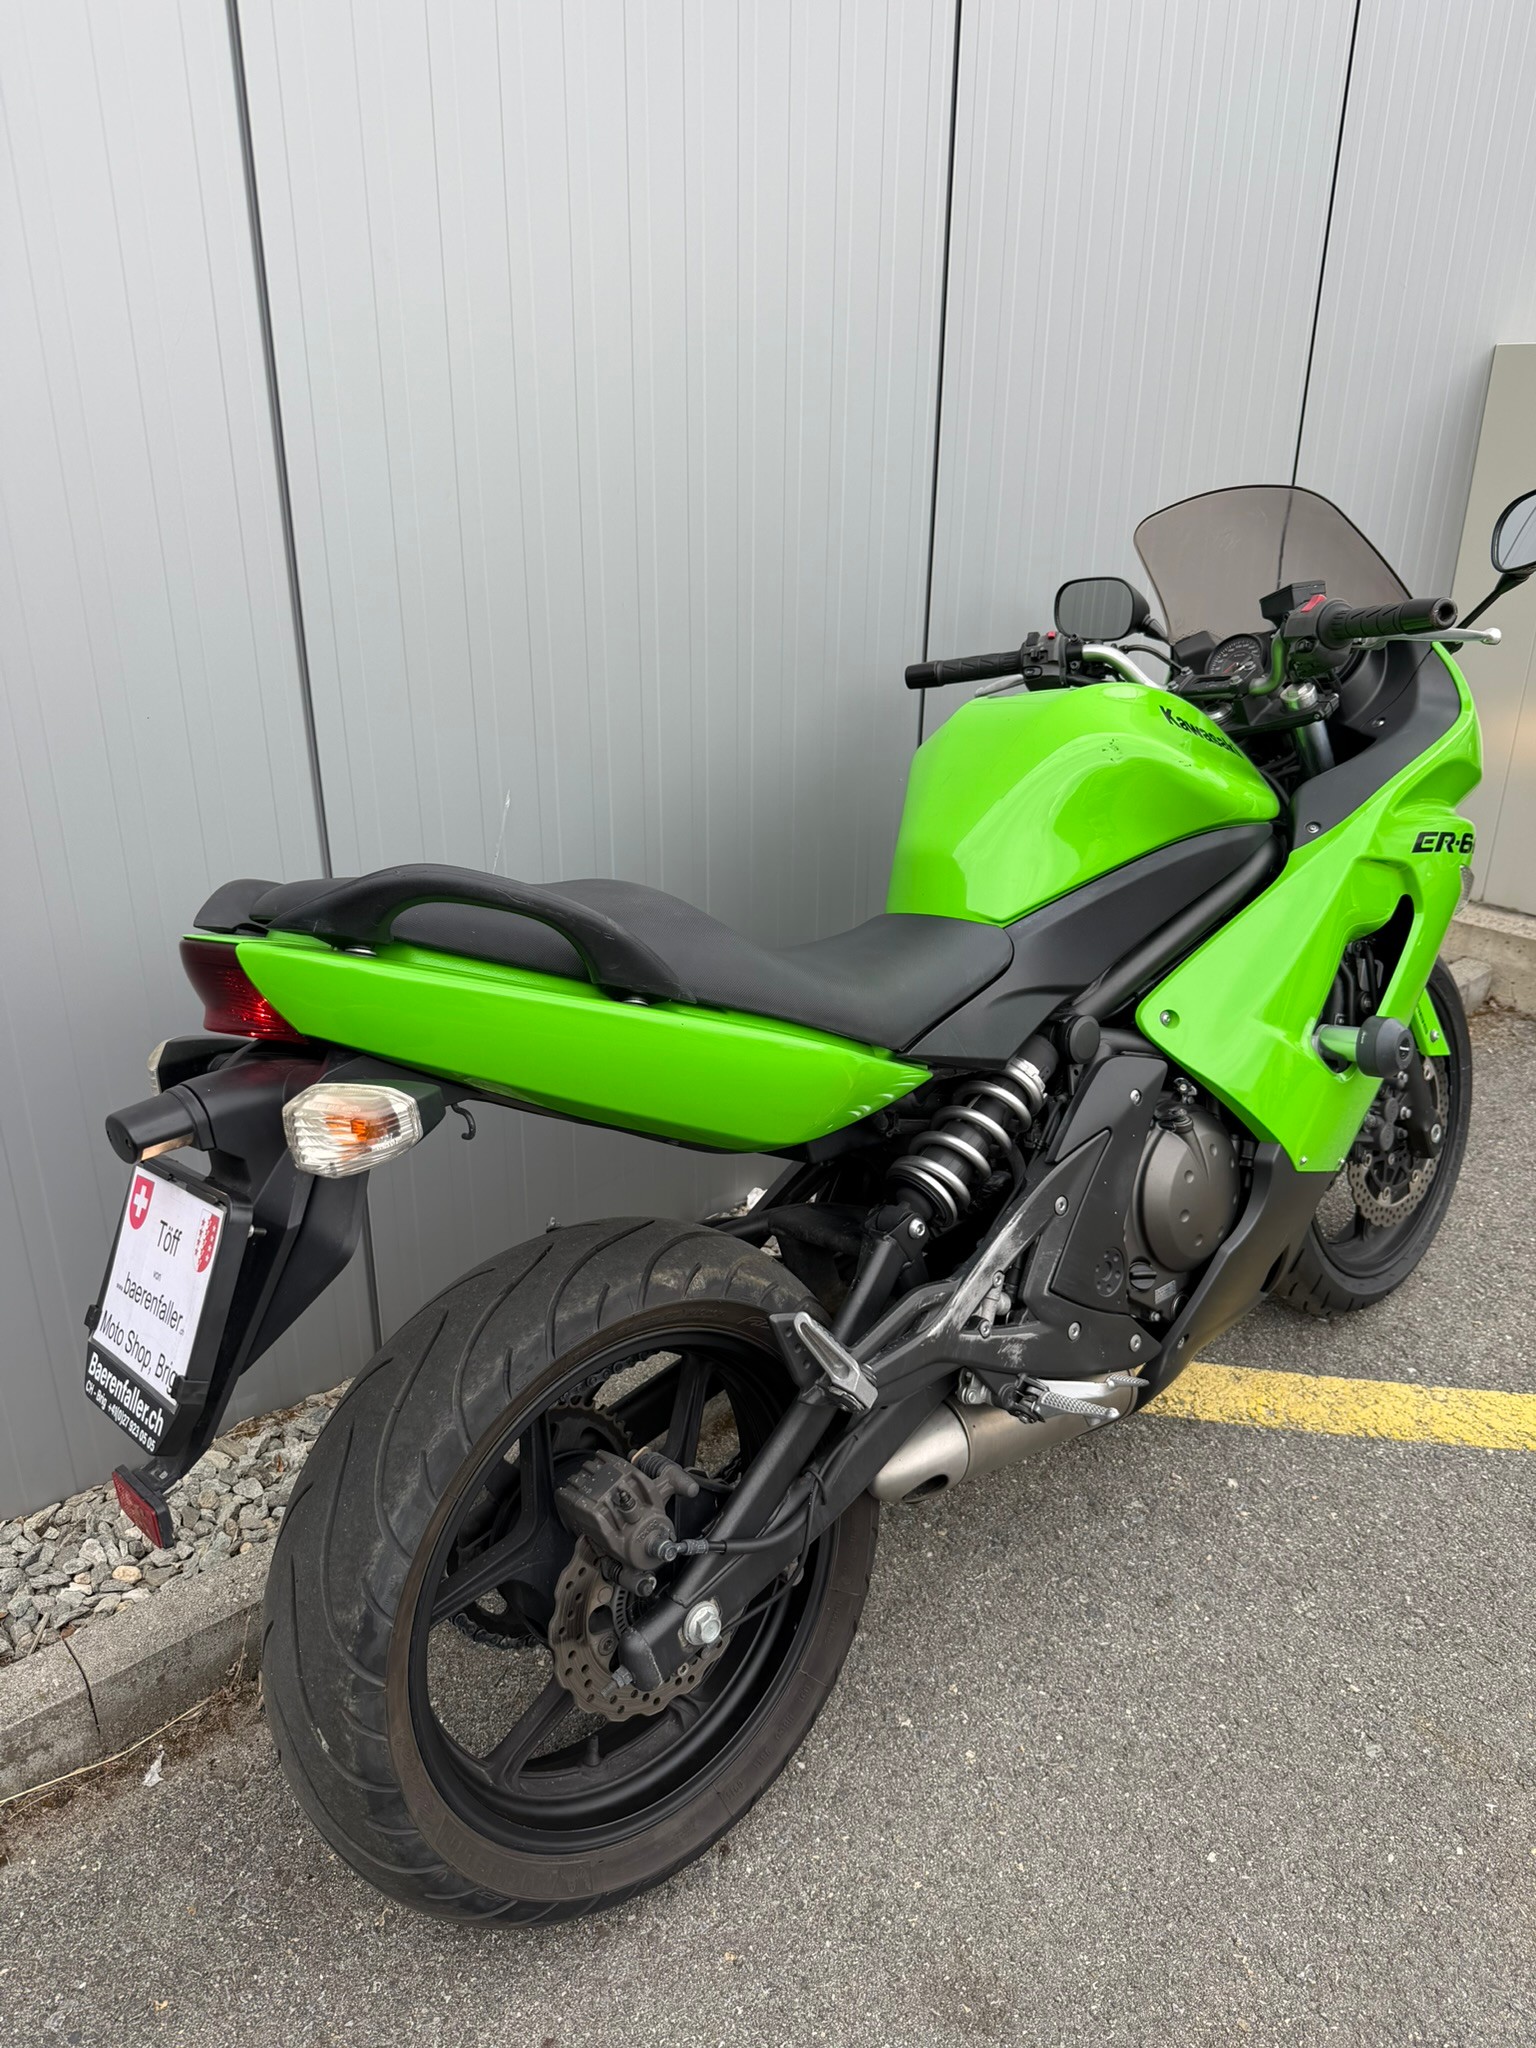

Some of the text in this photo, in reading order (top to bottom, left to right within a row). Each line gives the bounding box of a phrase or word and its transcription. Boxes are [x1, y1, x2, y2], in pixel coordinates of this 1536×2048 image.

[1412, 831, 1474, 854] ER-6
[157, 1219, 183, 1257] Töff
[99, 1309, 178, 1396] Moto Shop, Brig
[85, 1379, 95, 1396] CH
[96, 1388, 108, 1411] Brig
[128, 1419, 140, 1438] 923
[138, 1429, 148, 1445] 05
[146, 1436, 157, 1453] 05
[88, 1351, 164, 1437] Baerenfaller.ch
